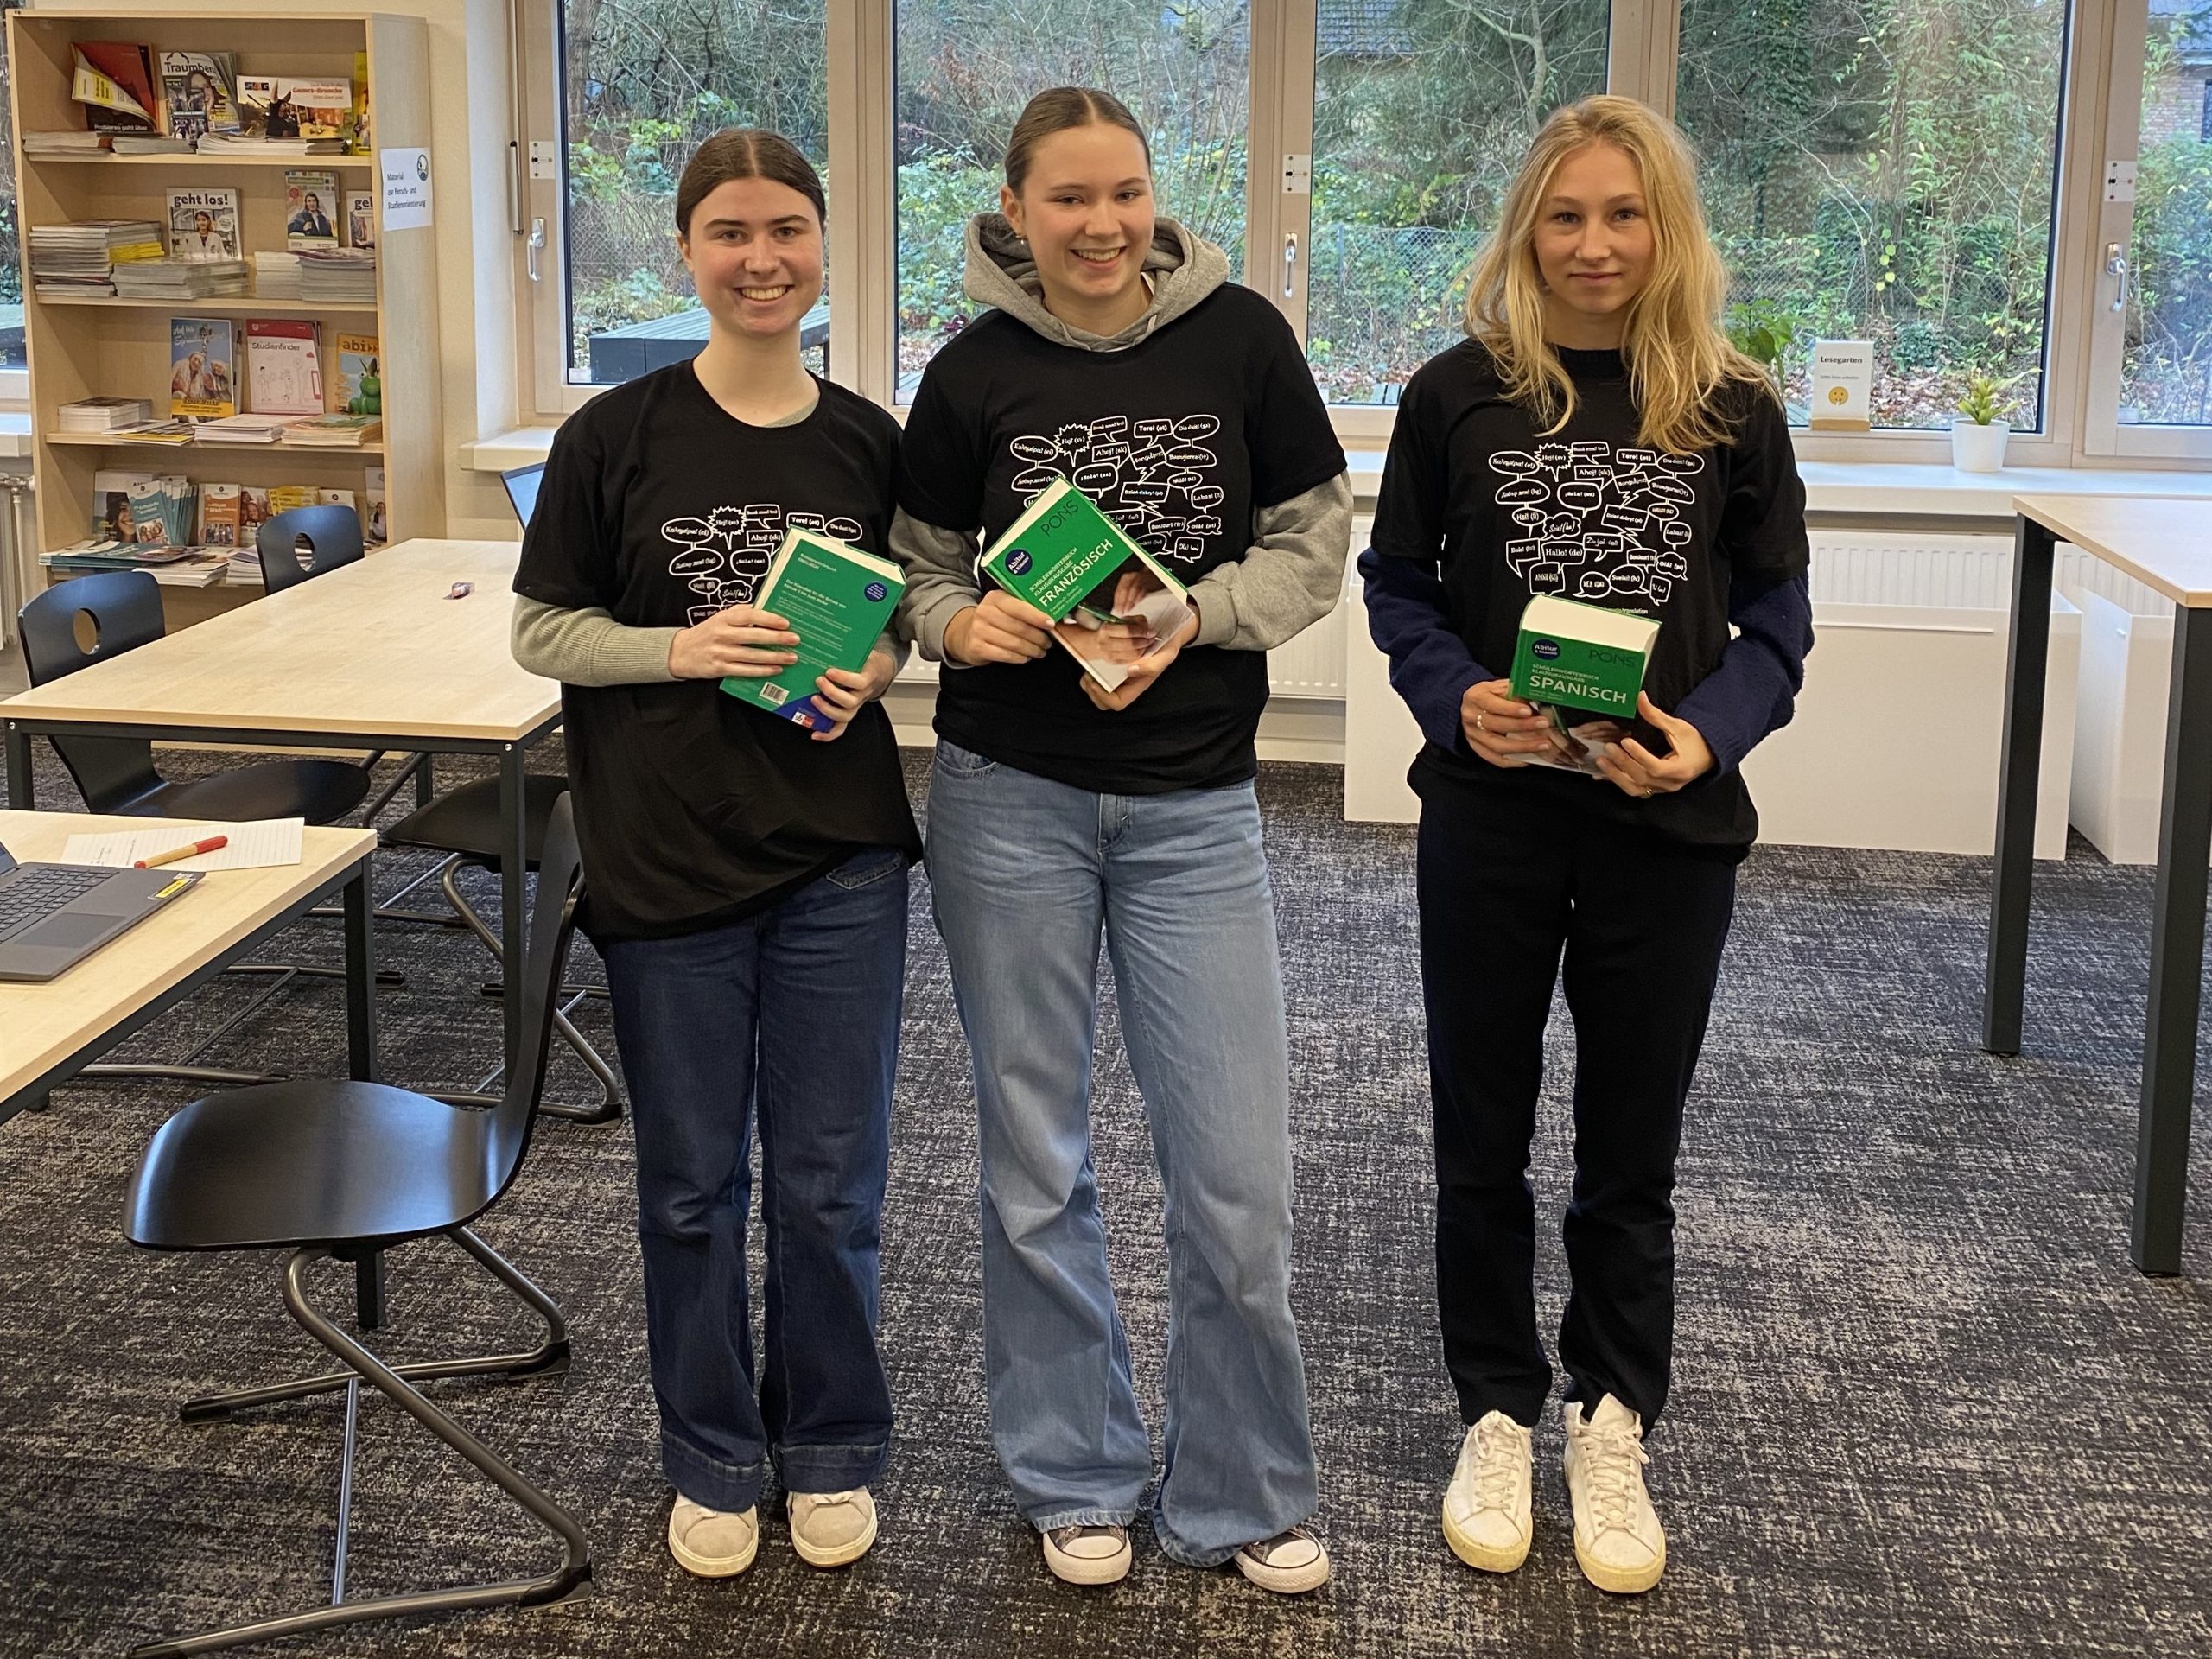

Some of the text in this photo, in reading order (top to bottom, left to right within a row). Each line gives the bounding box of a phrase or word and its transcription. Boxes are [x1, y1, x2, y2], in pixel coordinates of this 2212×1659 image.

[387, 172, 404, 181] Material
[174, 193, 228, 207] geht los!
[251, 342, 300, 351] Studienfinder
[343, 339, 366, 352] abi
[1096, 448, 1114, 456] Ahoj!
[1040, 499, 1078, 537] PONS
[1007, 551, 1025, 569] Abitur
[1039, 538, 1113, 607] FRANZÖSISCH
[1590, 650, 1636, 668] PONS
[1529, 676, 1626, 704] SPANISCH
